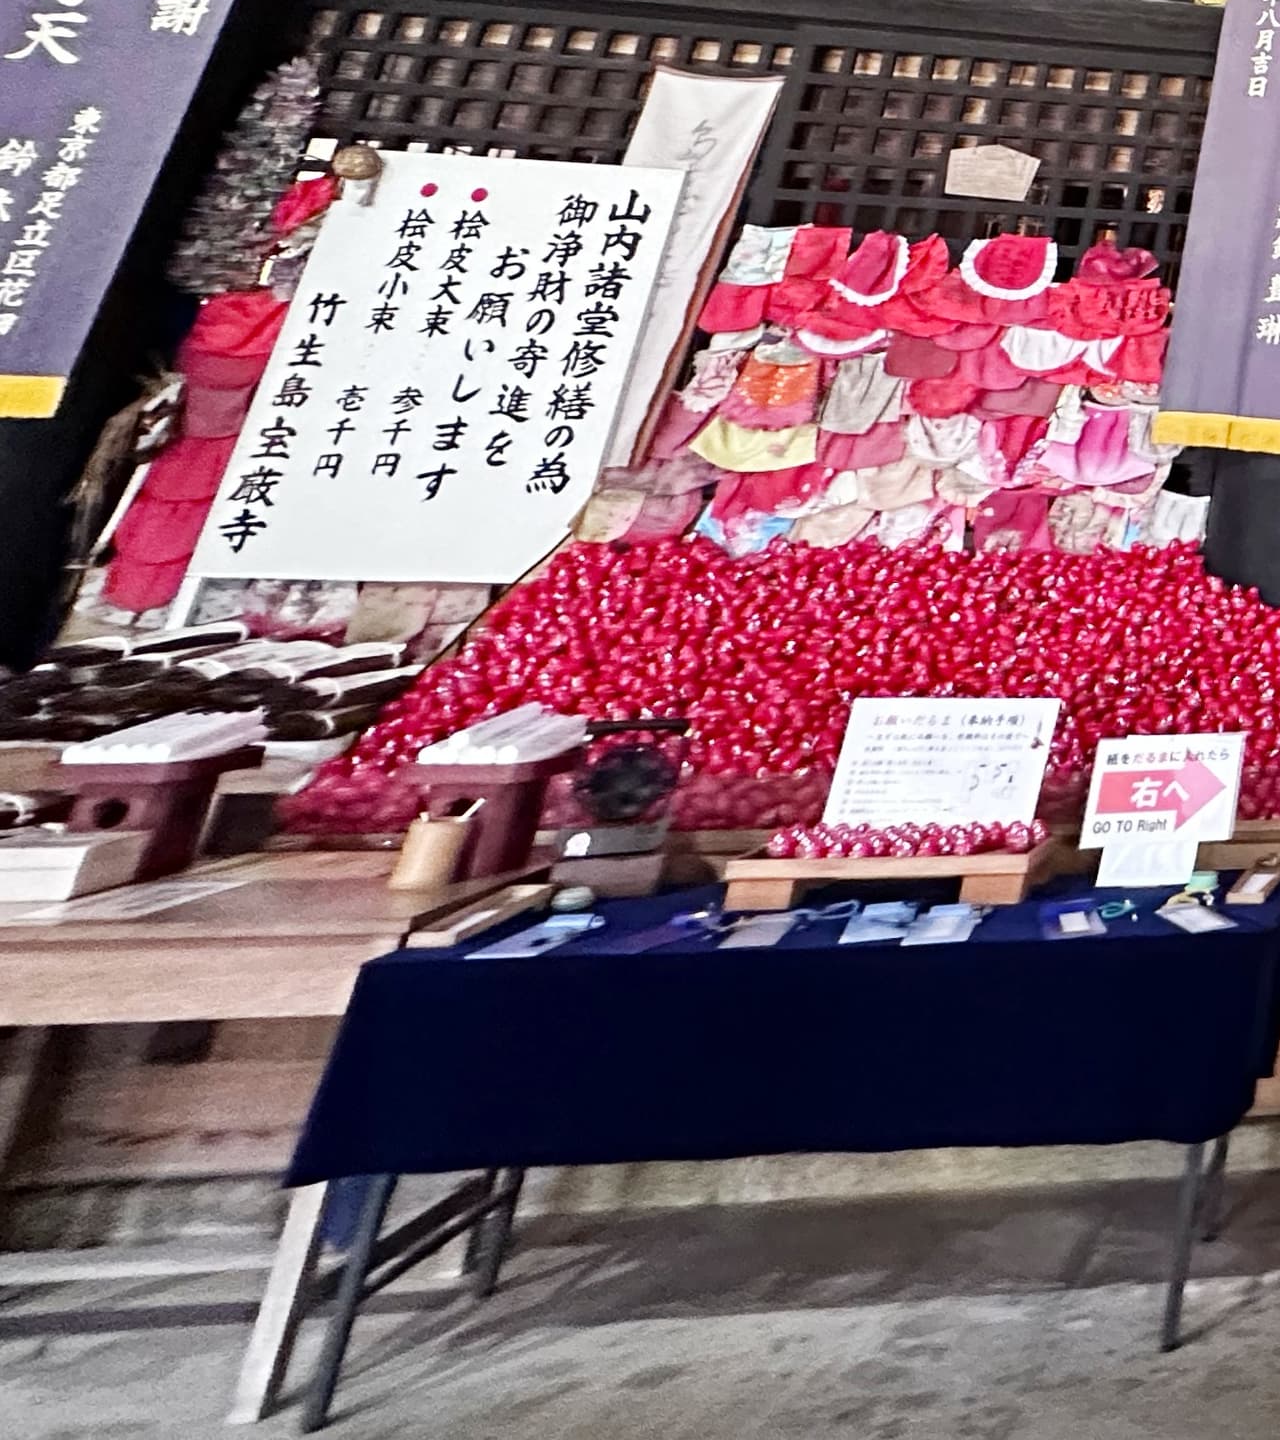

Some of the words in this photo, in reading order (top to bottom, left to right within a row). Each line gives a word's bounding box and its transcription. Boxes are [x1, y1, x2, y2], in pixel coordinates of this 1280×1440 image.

[416, 246, 531, 503] お願いします
[484, 194, 599, 467] 御浄財の寄進を
[525, 188, 652, 495] 山内諸堂修繕の為
[1092, 821, 1111, 835] GO
[1116, 819, 1133, 833] TO
[1136, 818, 1168, 834] Right
[1129, 776, 1190, 808] 右へ
